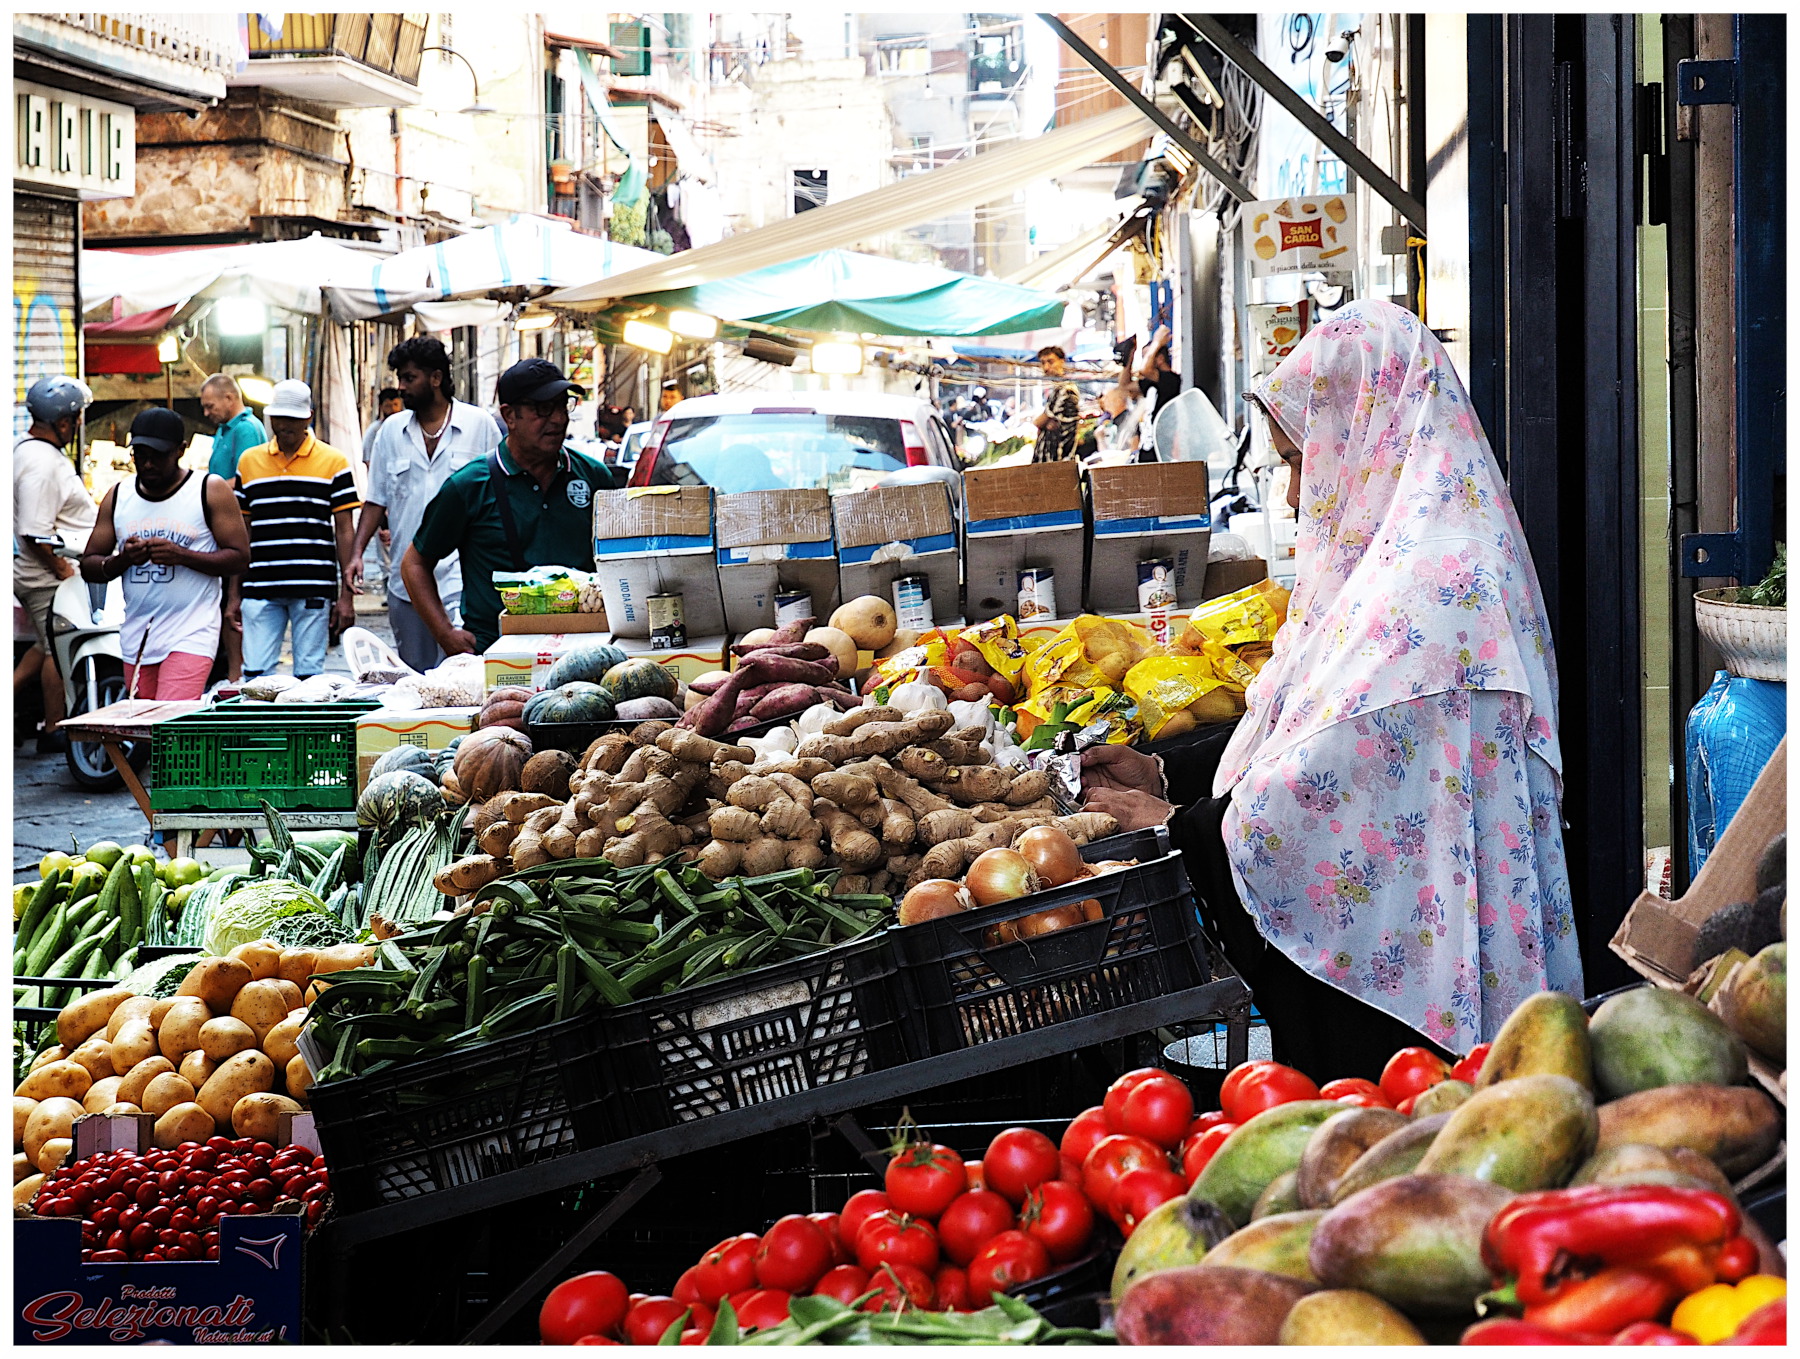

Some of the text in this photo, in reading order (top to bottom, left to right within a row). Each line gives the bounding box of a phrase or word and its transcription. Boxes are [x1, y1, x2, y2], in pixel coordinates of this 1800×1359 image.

[26, 94, 124, 180] ARIA
[1289, 226, 1312, 235] SAN
[1284, 234, 1319, 244] CARLO
[1276, 264, 1299, 274] piacer
[619, 578, 636, 622] LATO DA APRIRE
[121, 1284, 176, 1300] Prodotti
[21, 1290, 256, 1342] Selezionati
